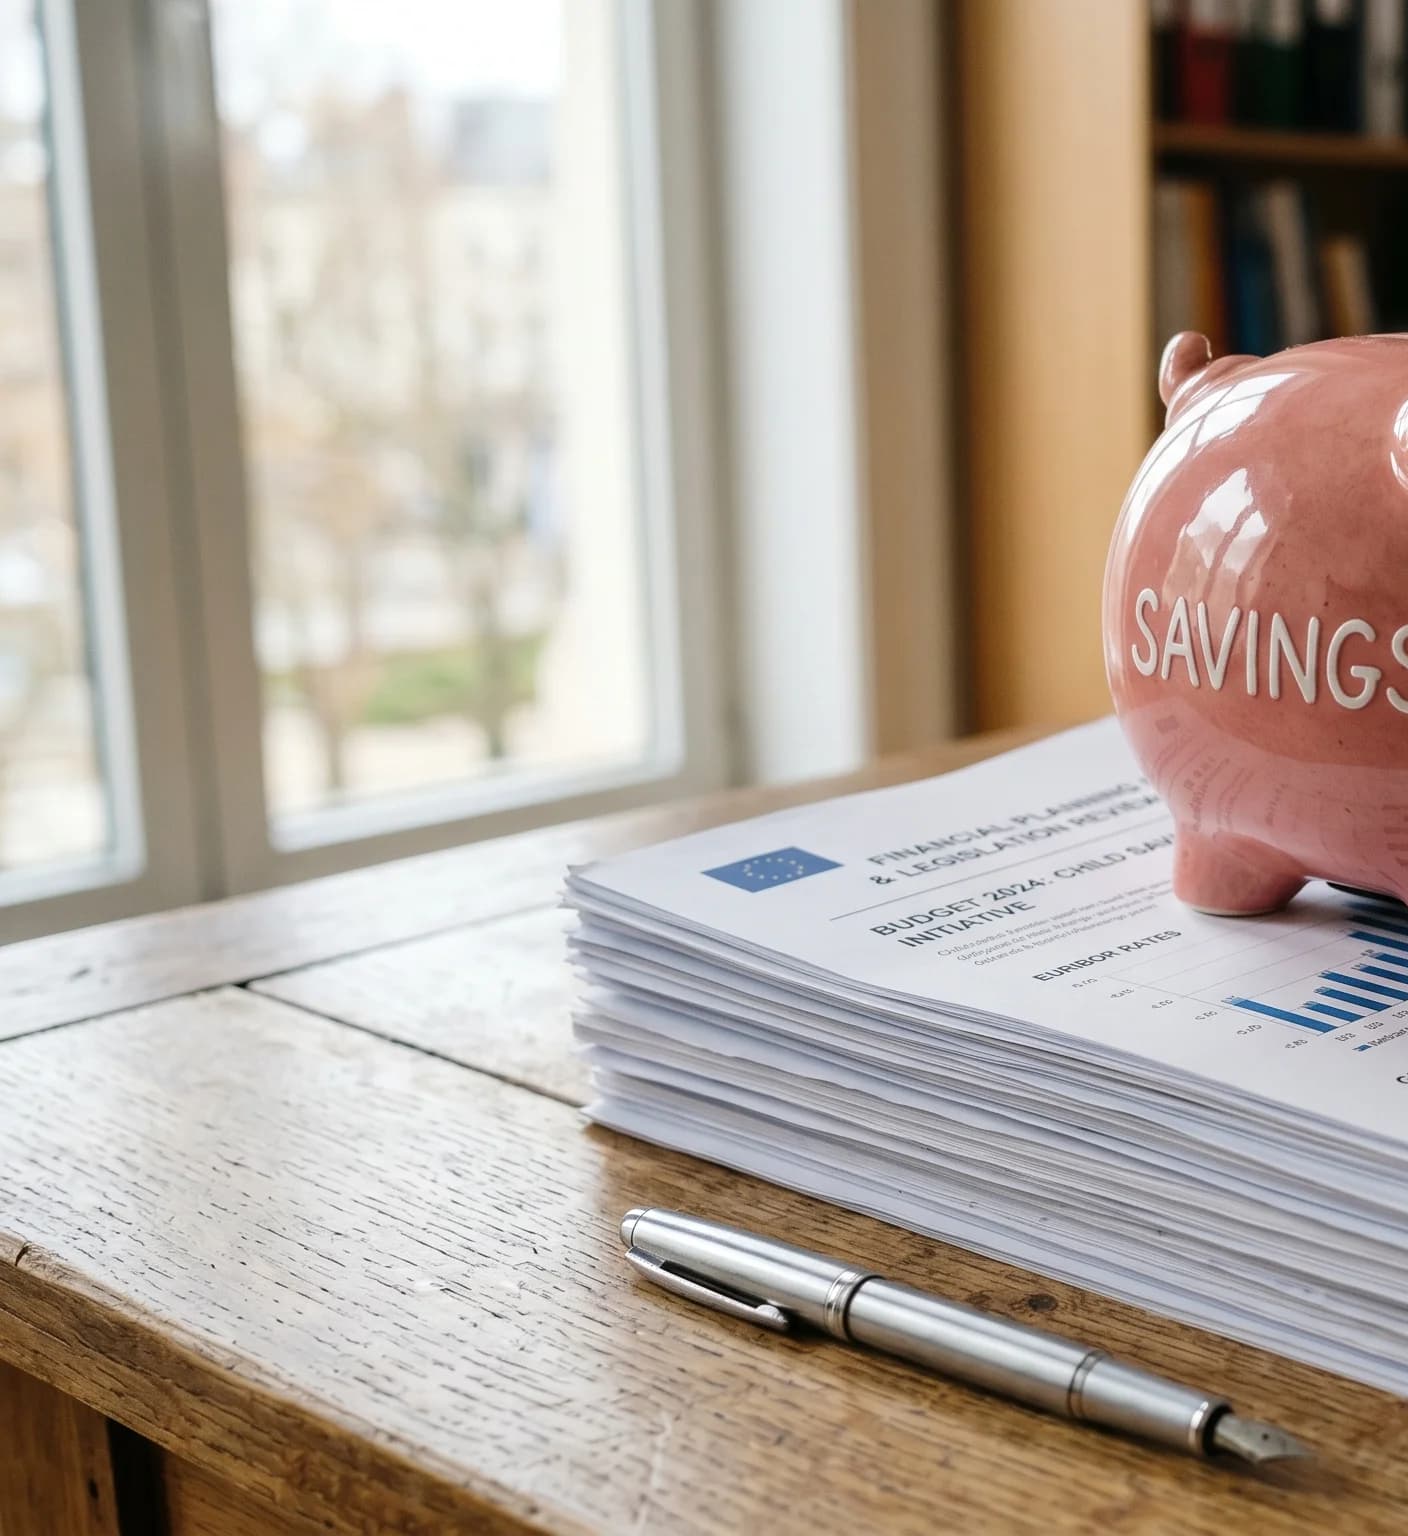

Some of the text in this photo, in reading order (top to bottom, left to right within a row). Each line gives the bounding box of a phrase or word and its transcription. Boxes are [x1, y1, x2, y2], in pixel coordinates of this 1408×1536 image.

[867, 824, 1016, 866] FINANCIAL
[869, 875, 897, 885] &
[896, 824, 1070, 877] LEGISLATION
[869, 897, 981, 936] BUDGET
[1053, 852, 1126, 878] CHILD
[897, 900, 1037, 948] INITIATIVE
[1032, 930, 1182, 982] EURIBOR RATES
